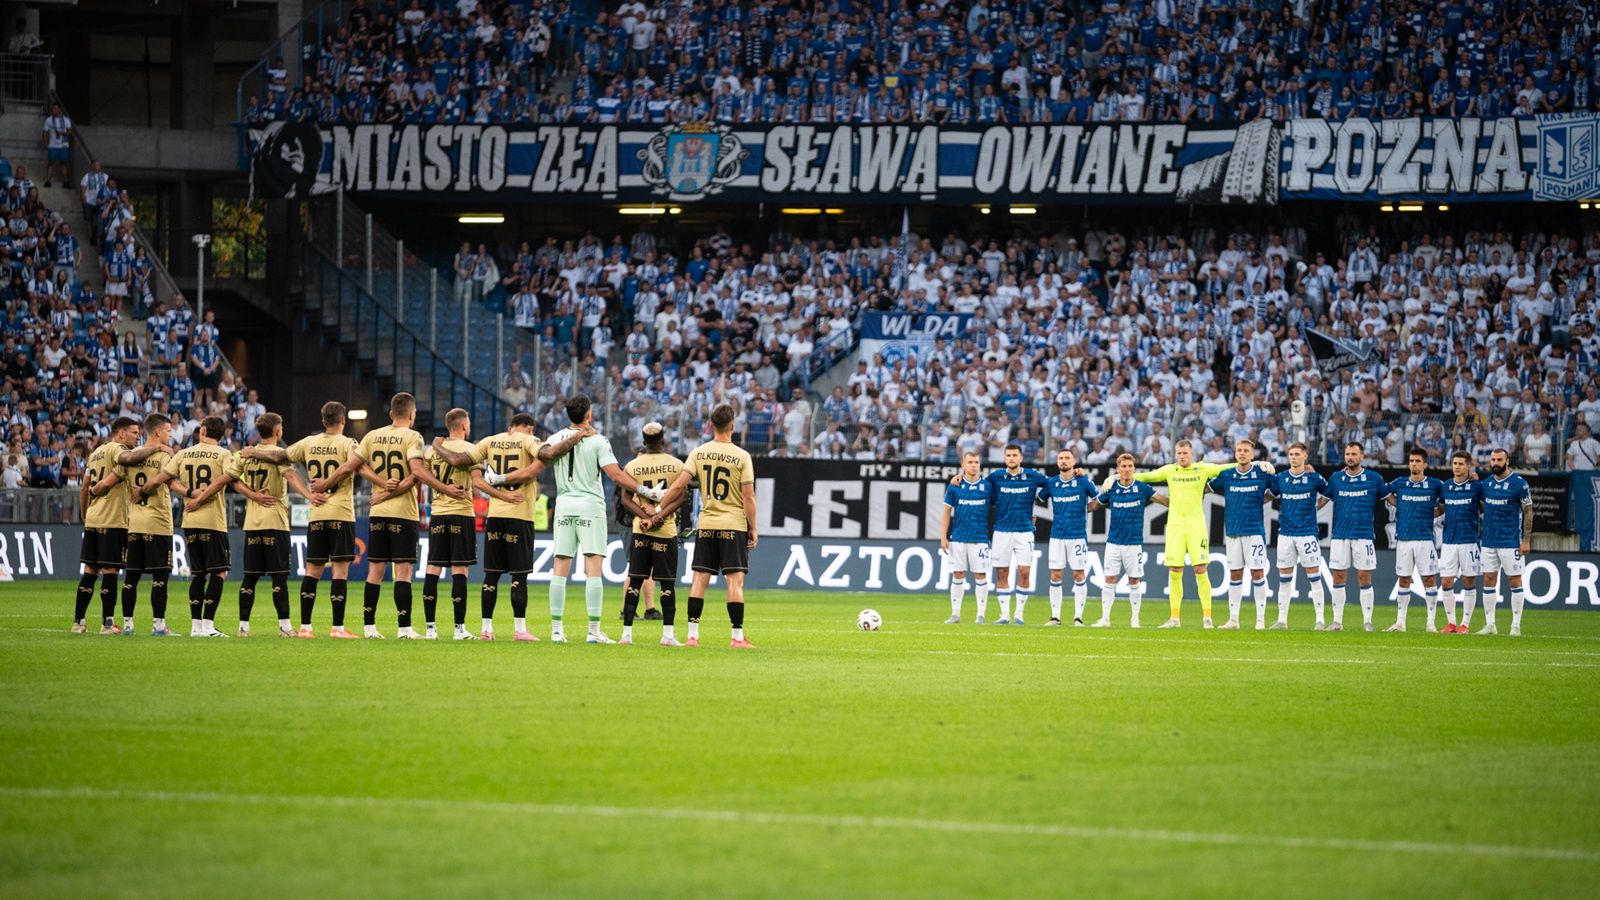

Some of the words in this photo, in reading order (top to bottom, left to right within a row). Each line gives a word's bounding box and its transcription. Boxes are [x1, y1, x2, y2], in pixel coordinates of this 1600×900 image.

[1286, 116, 1528, 194] POZNA
[332, 124, 508, 191] MIASTO
[531, 126, 618, 199] ZŁĄ
[761, 125, 938, 200] SŁAWĄ
[974, 124, 1186, 193] OWIANE
[489, 441, 523, 450] MASSIMO
[184, 450, 219, 460] AMBROS
[696, 452, 741, 466] OLKOWSKI
[372, 450, 405, 482] 26
[633, 464, 677, 476] ISMAHEEL
[185, 464, 212, 492] 18
[247, 468, 268, 491] 17
[703, 464, 731, 501] 16
[1000, 486, 1029, 494] SUPERBET
[1282, 492, 1311, 500] SUPERBET
[1113, 500, 1141, 508] SUPERBET
[1402, 494, 1431, 502] SUPERBET
[1074, 544, 1087, 556] 24
[1251, 545, 1264, 557] 72
[1304, 541, 1318, 554] 23
[1365, 544, 1374, 556] 16
[1137, 552, 1143, 564] 2
[1429, 550, 1435, 561] 4
[1469, 551, 1480, 562] 14
[1514, 550, 1520, 561] 9
